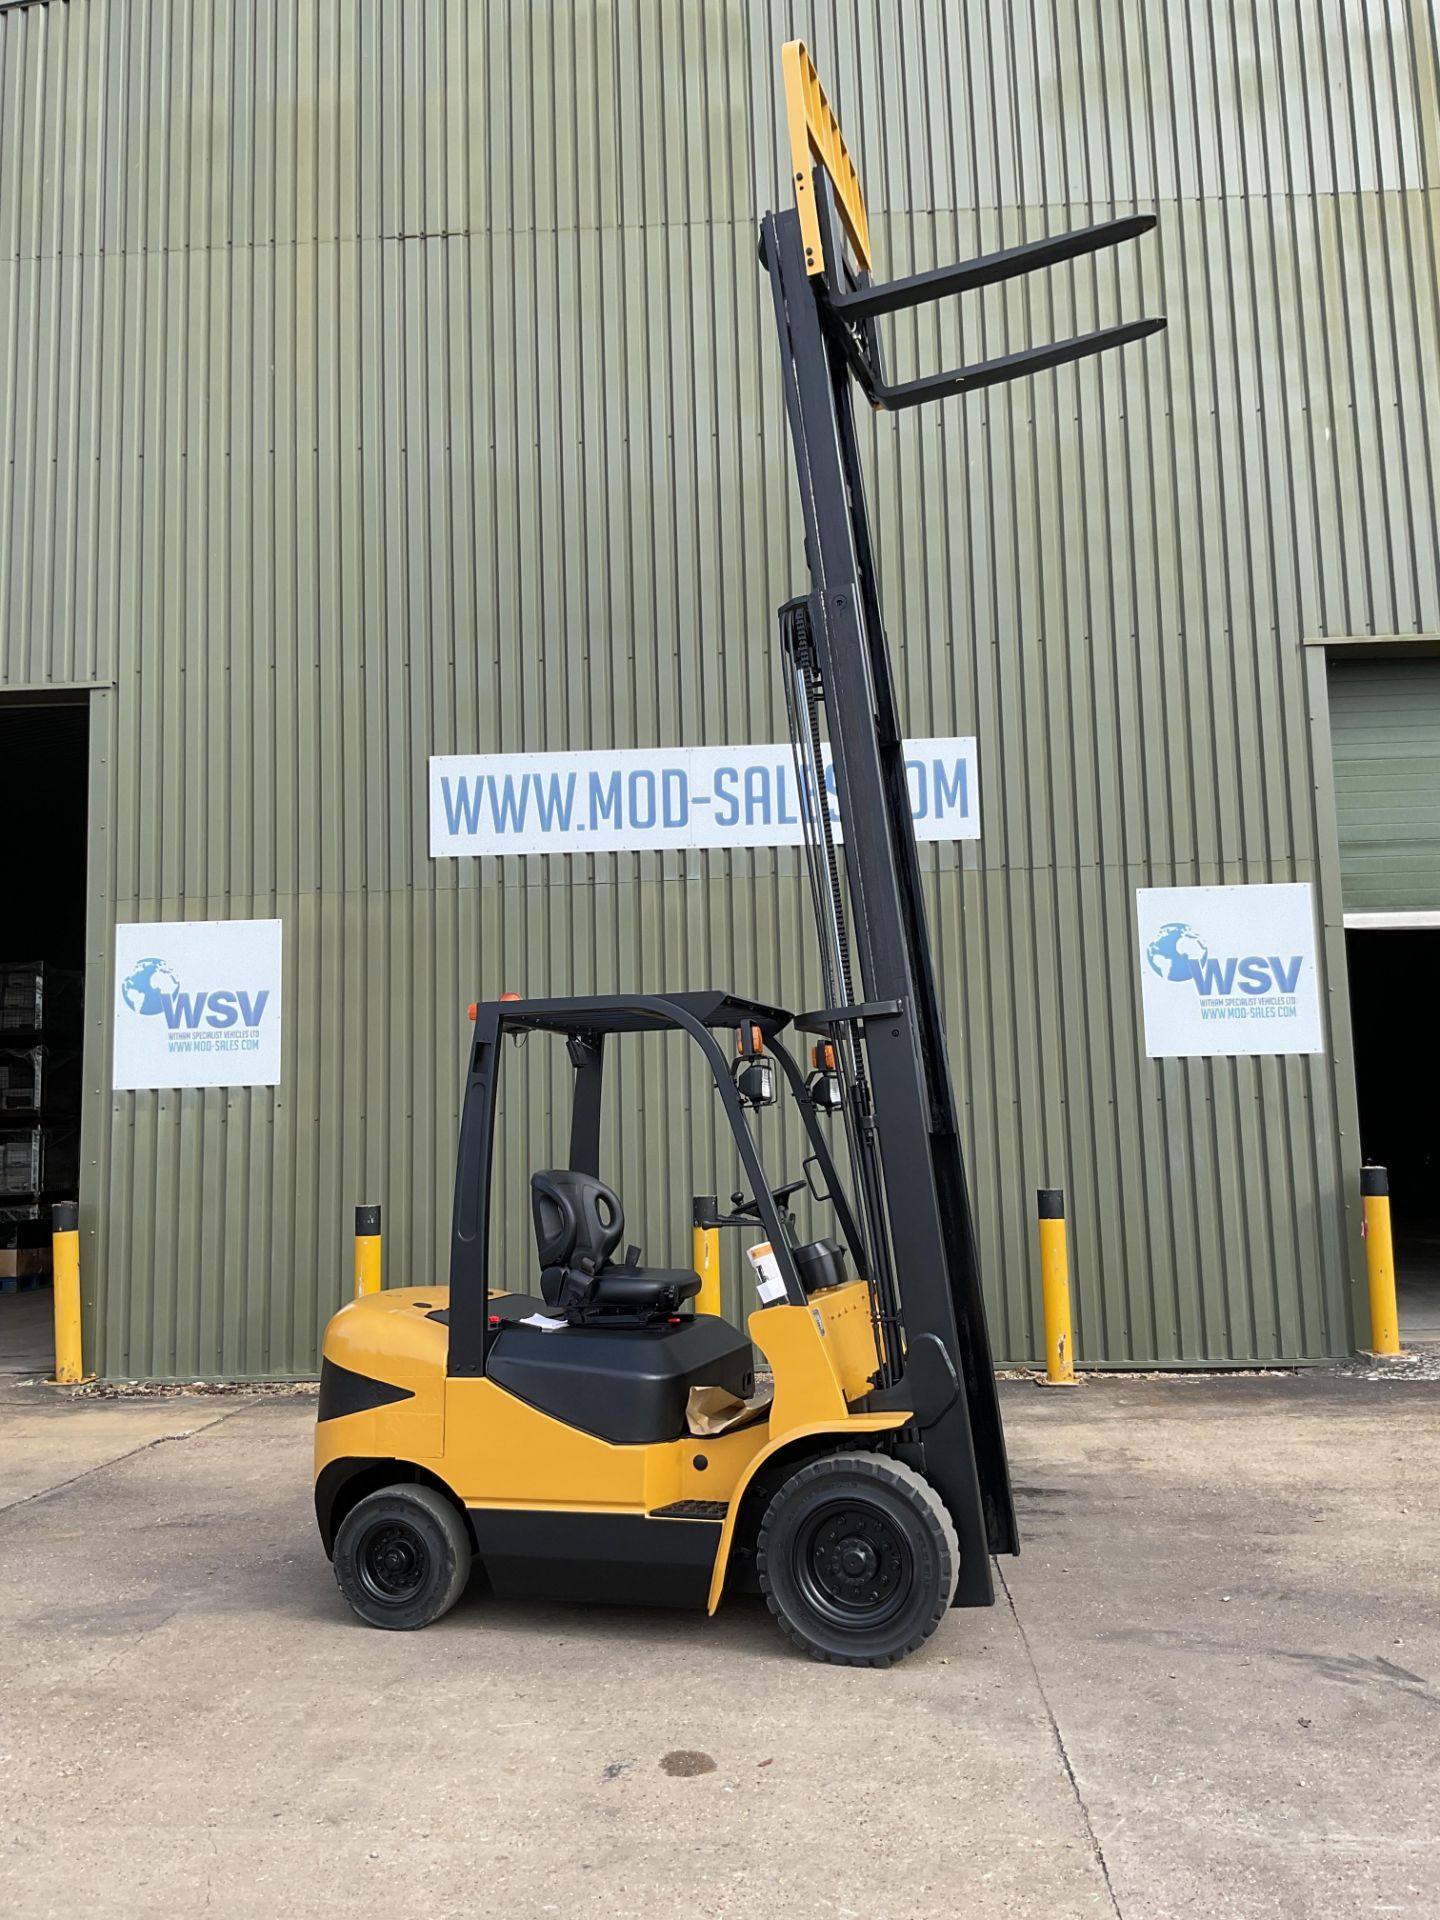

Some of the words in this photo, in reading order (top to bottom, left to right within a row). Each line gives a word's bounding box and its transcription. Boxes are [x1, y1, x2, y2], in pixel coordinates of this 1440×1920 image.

[1188, 956, 1303, 995] WSV
[161, 990, 269, 1029] WSV
[1225, 997, 1257, 1006] SPECIALIST
[1258, 996, 1285, 1005] VEHICLES
[192, 1031, 222, 1040] SPECIALIST
[224, 1030, 249, 1039] VEHICLES
